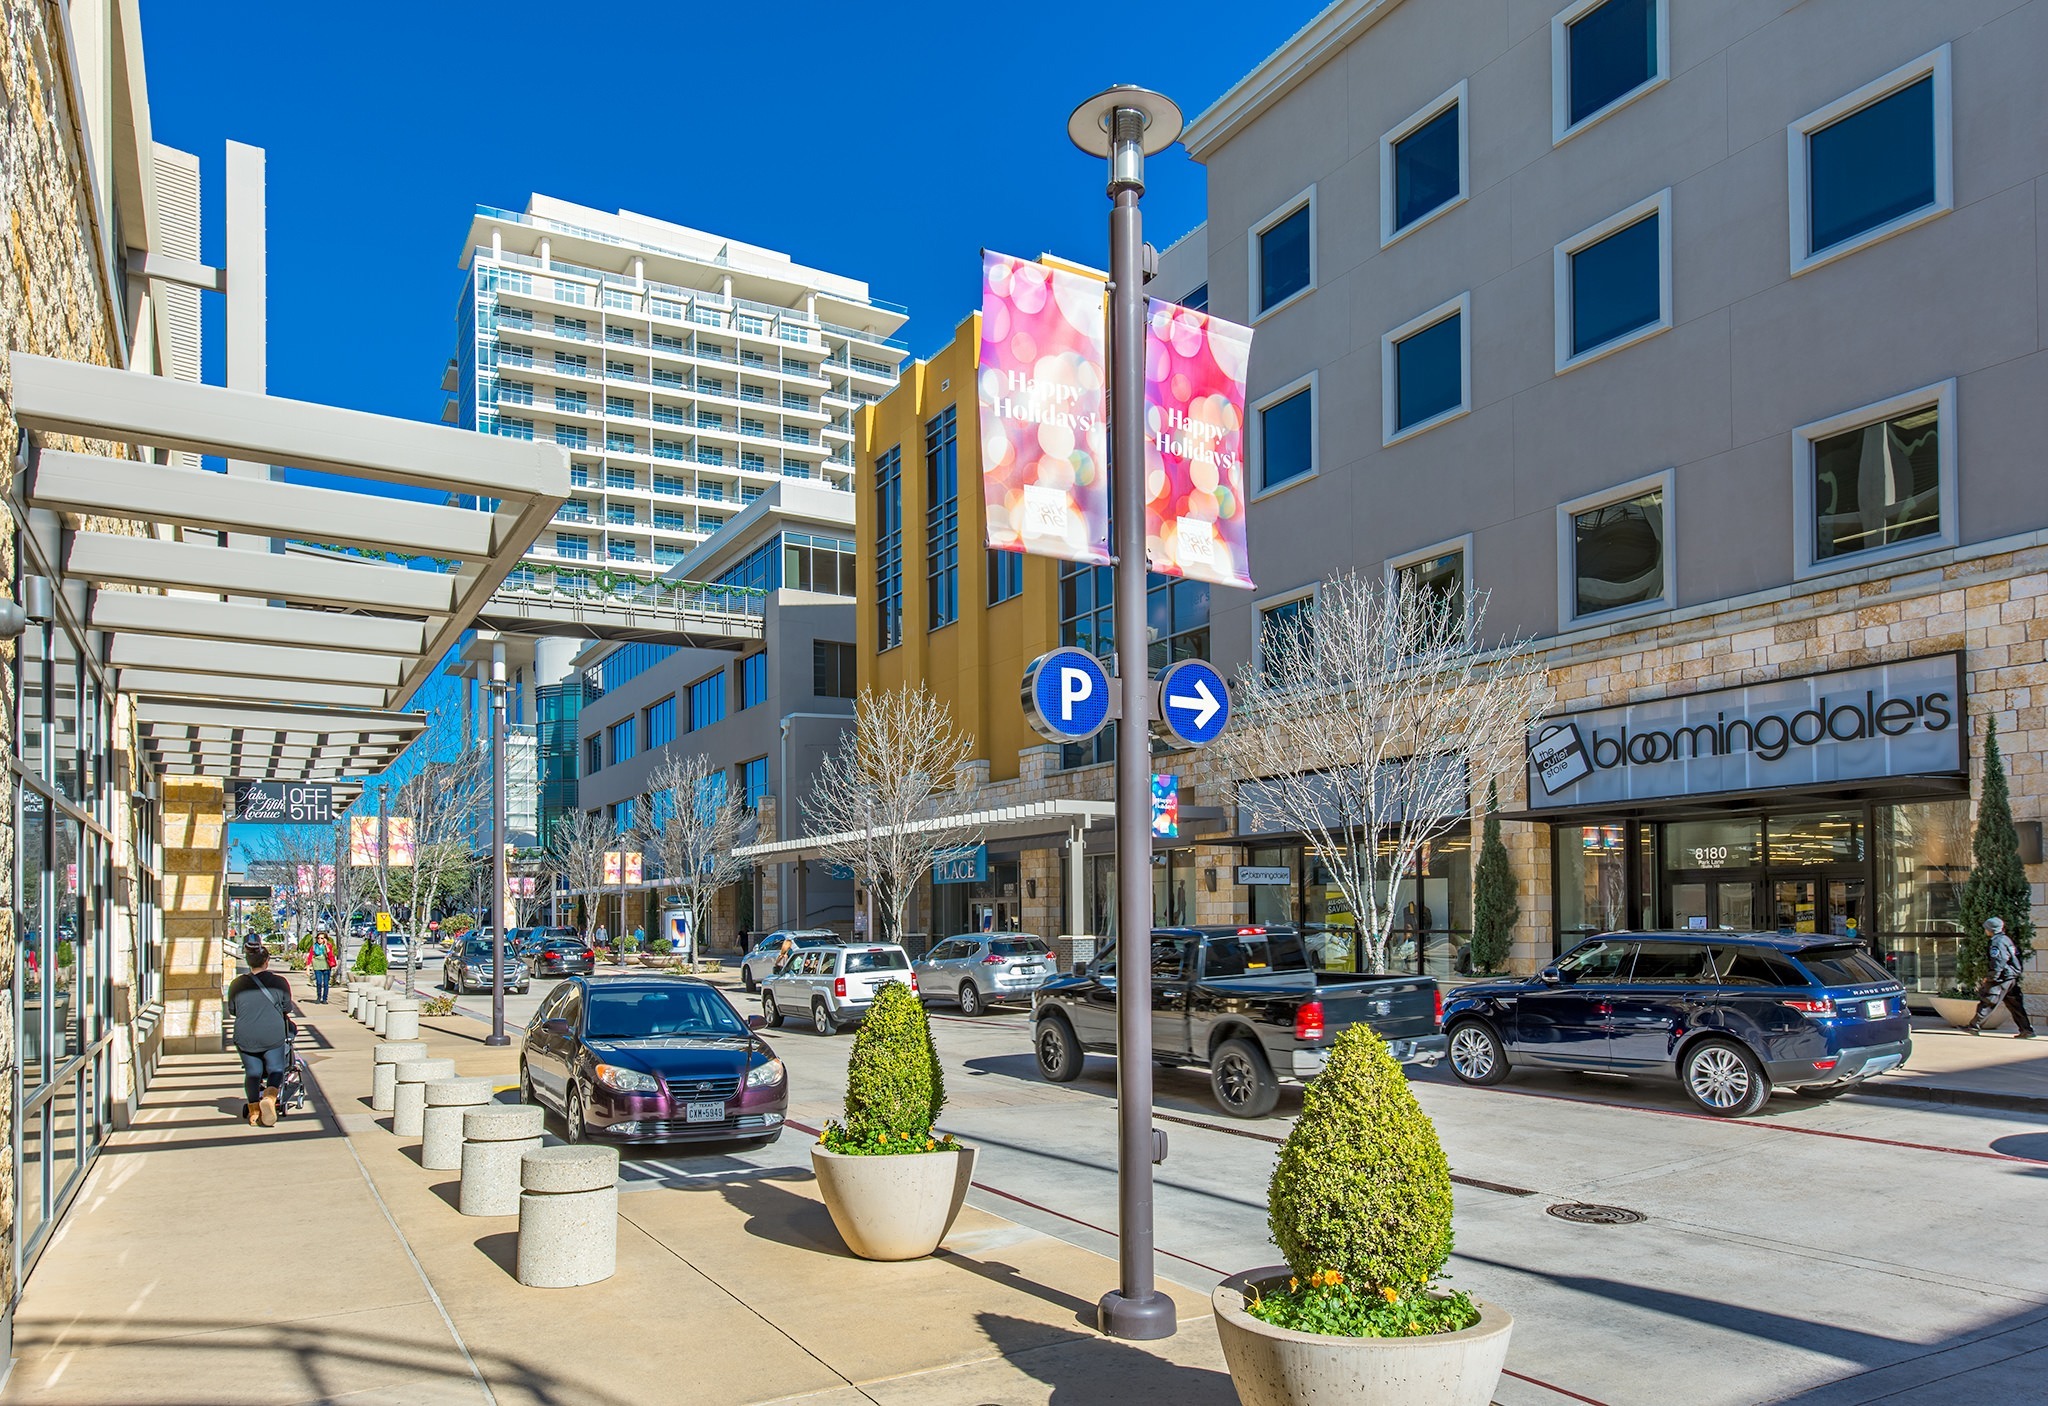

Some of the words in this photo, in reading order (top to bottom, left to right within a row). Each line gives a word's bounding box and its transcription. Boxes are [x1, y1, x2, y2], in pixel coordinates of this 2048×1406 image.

[1008, 370, 1082, 407] Happy
[993, 396, 1096, 433] Holidays!
[1168, 407, 1226, 446] Happy
[1156, 431, 1236, 470] Holidays!
[1061, 667, 1093, 721] P
[1592, 690, 1951, 769] bloomingdale's
[1539, 747, 1555, 760] the
[1543, 749, 1568, 769] outlet
[1546, 761, 1568, 778] store
[235, 787, 267, 804] Saks
[253, 798, 285, 811] Fifth
[289, 787, 327, 804] OFF
[236, 804, 281, 821] Avenue
[290, 804, 327, 820] 5TH
[1695, 846, 1727, 860] 8180
[938, 860, 975, 880] PLACE
